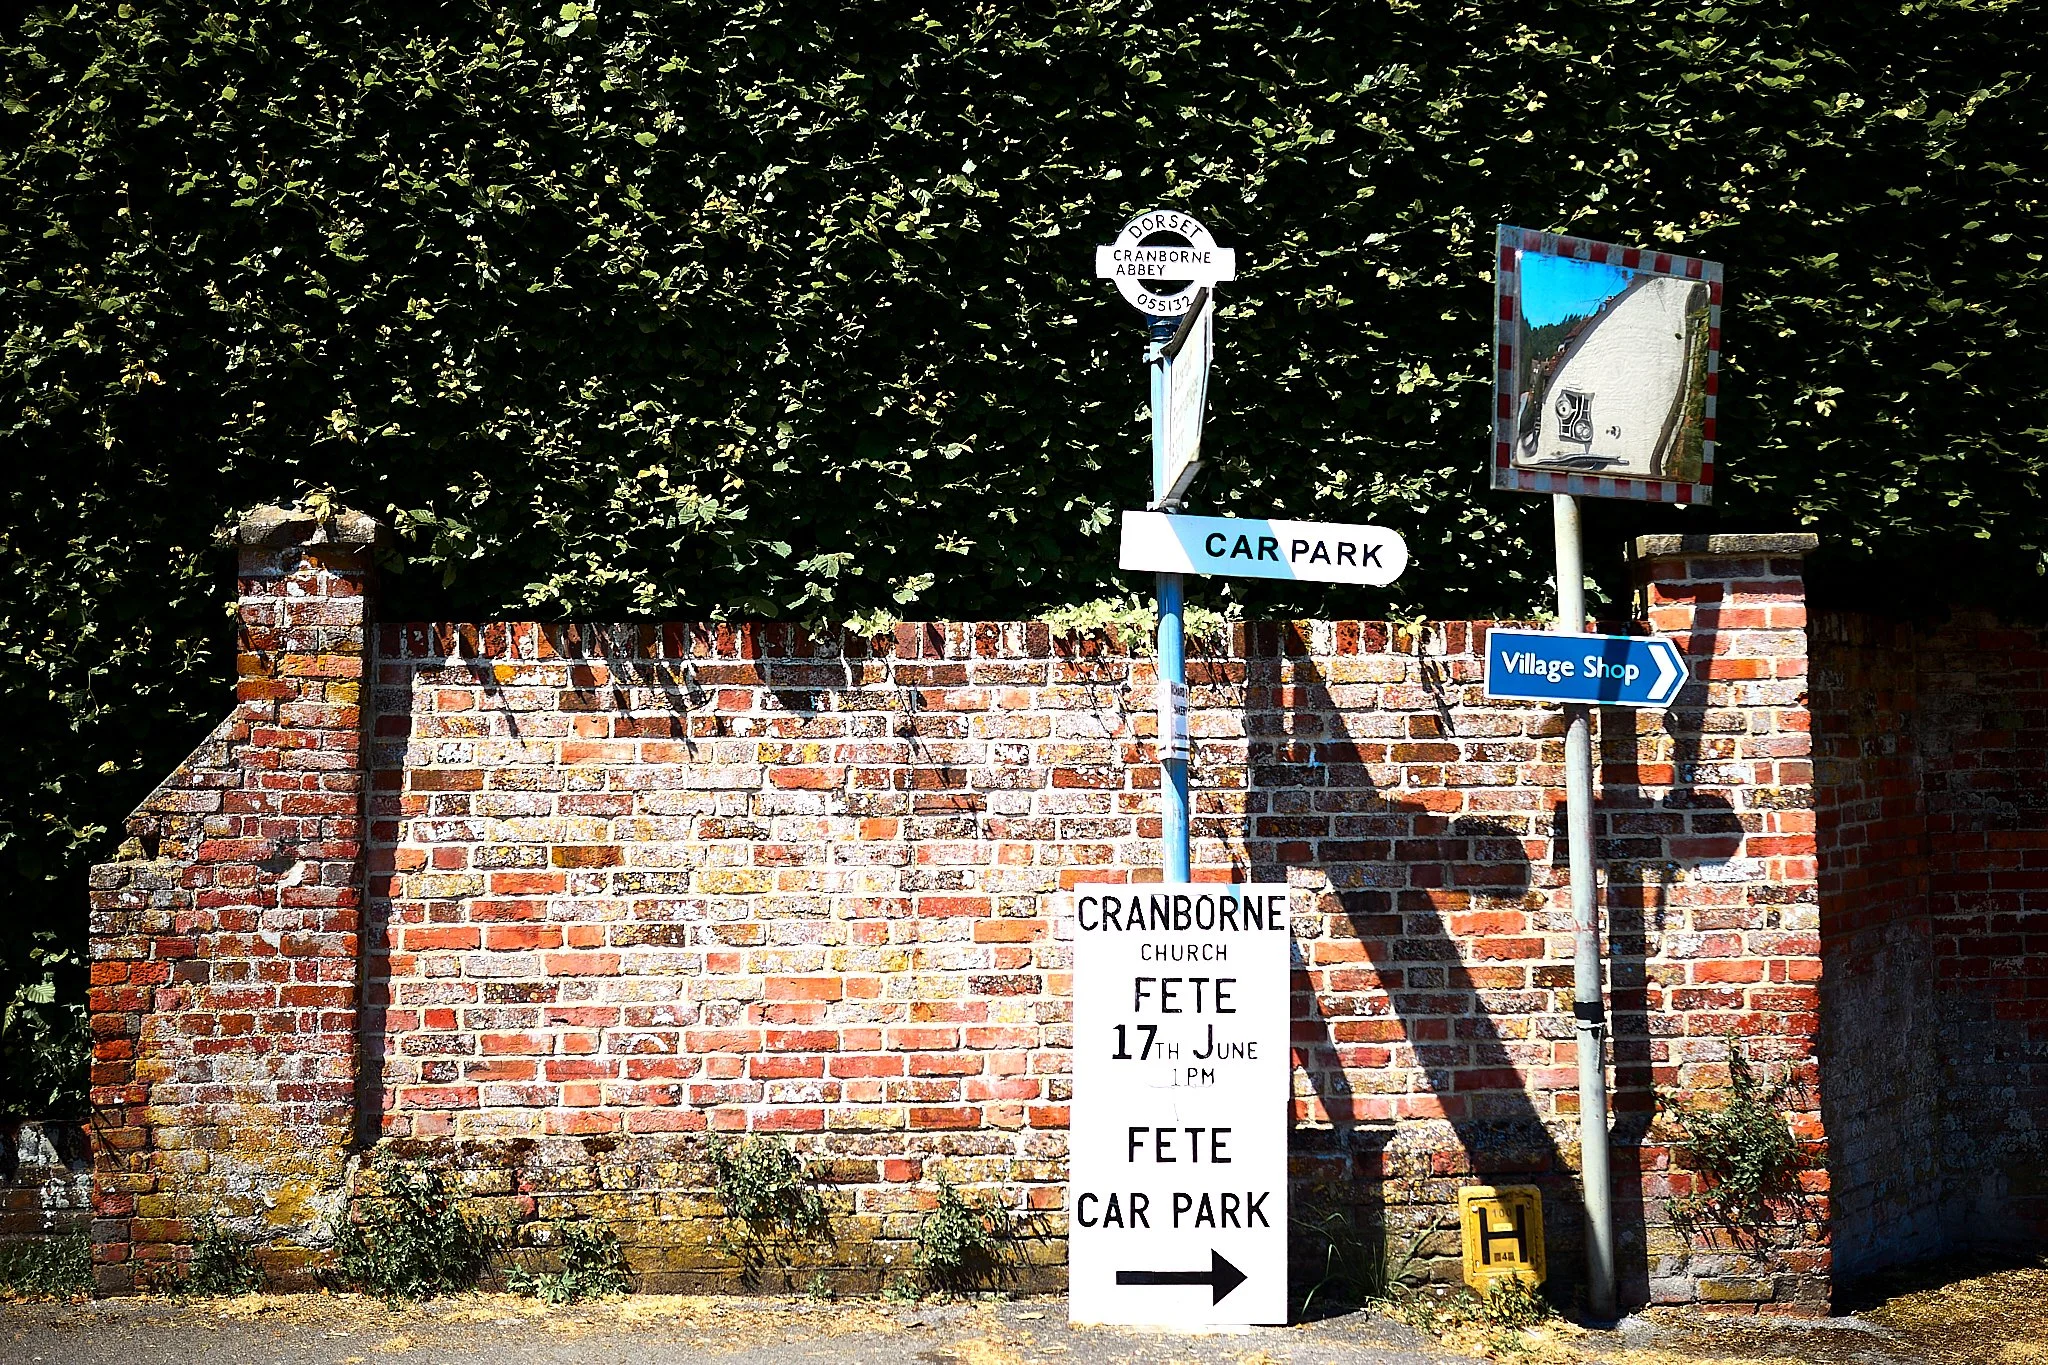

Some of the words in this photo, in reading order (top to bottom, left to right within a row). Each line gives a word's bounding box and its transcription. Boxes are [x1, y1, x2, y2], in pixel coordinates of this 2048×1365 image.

[1128, 214, 1203, 239] DORSET
[1113, 249, 1212, 264] CRANBORNE
[1116, 263, 1167, 276] ABBEY
[1137, 293, 1193, 312] 055132
[1205, 532, 1280, 562] CAR
[1291, 539, 1384, 569] PARK
[1501, 650, 1575, 683] Village
[1583, 655, 1640, 686] Shop
[1077, 894, 1286, 932] CRANBORNE
[1140, 943, 1228, 962] CHURCH
[1134, 976, 1237, 1014] FETE
[1111, 1023, 1179, 1061] 17TH
[1192, 1023, 1259, 1060] JUNE
[1128, 1126, 1232, 1163] FETE
[1077, 1192, 1151, 1229] CAR
[1172, 1191, 1270, 1229] PARK
[1478, 1203, 1529, 1266] H
